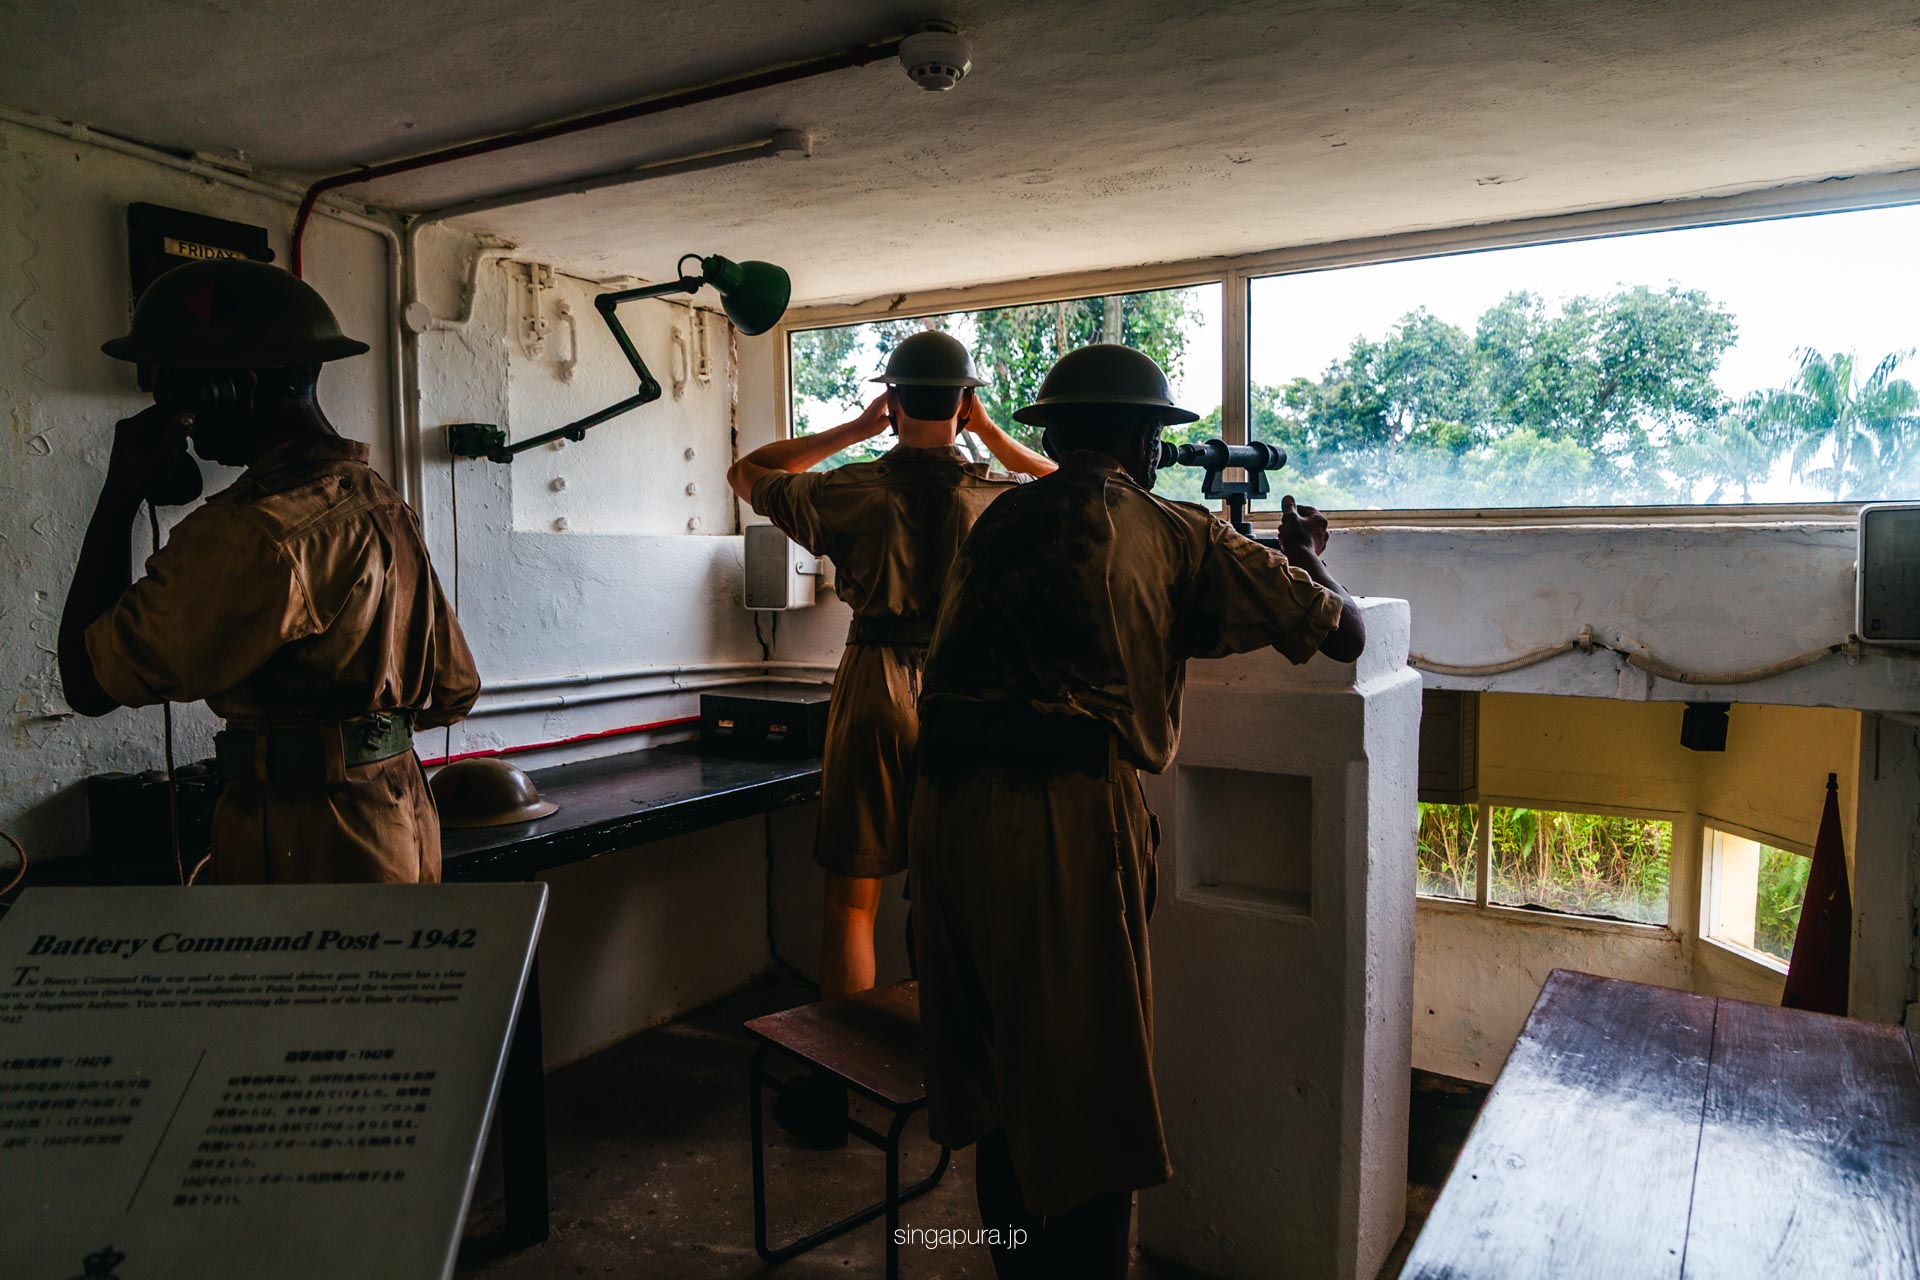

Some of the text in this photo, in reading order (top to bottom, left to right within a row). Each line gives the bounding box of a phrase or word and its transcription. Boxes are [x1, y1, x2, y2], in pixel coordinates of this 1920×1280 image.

[178, 241, 236, 260] FRIDAY
[27, 934, 149, 959] Battery
[152, 931, 314, 953] Command
[315, 929, 381, 951] Post
[408, 928, 477, 950] 1942
[84, 975, 138, 985] Command
[368, 970, 389, 980] This
